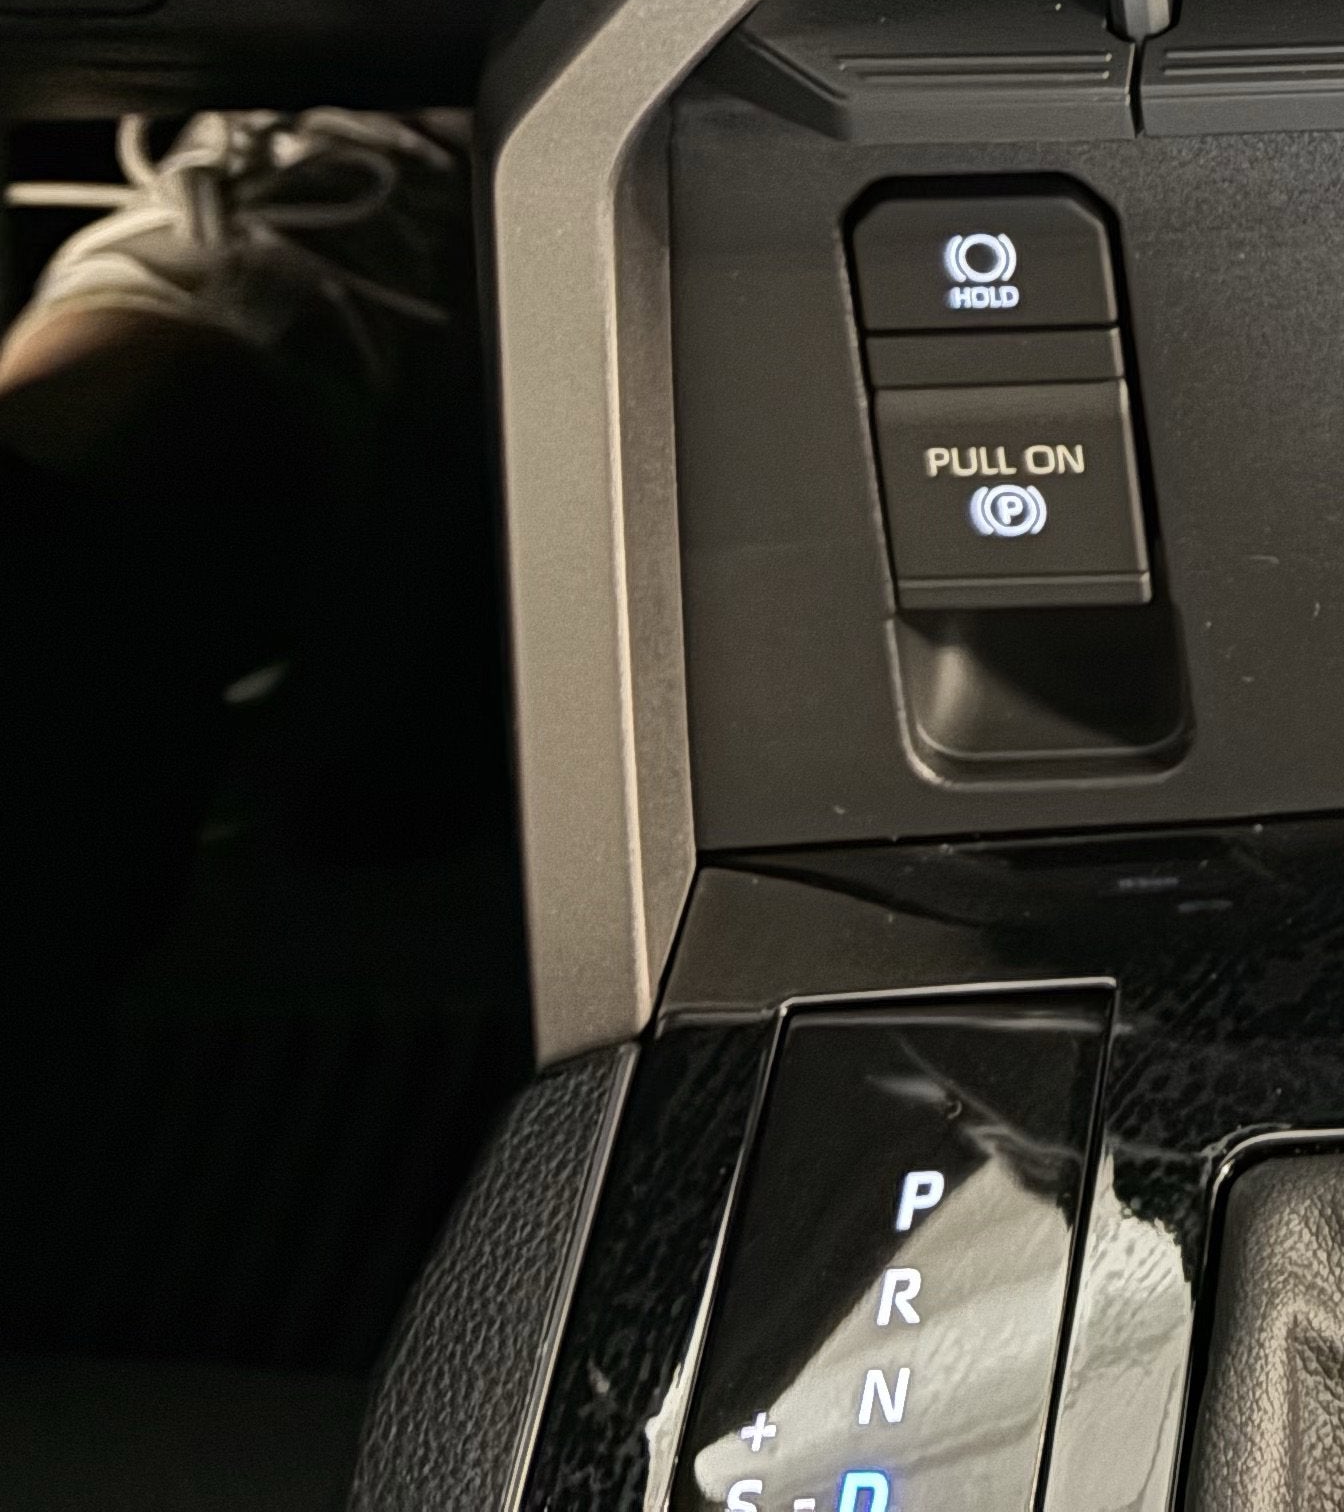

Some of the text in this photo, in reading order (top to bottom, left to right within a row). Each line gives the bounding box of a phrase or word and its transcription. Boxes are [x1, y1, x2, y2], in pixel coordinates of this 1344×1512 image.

[949, 286, 1019, 309] HOLD
[926, 444, 1085, 477] PULL ON
[896, 1170, 945, 1230] P
[876, 1267, 922, 1326] R
[858, 1368, 911, 1425] N
